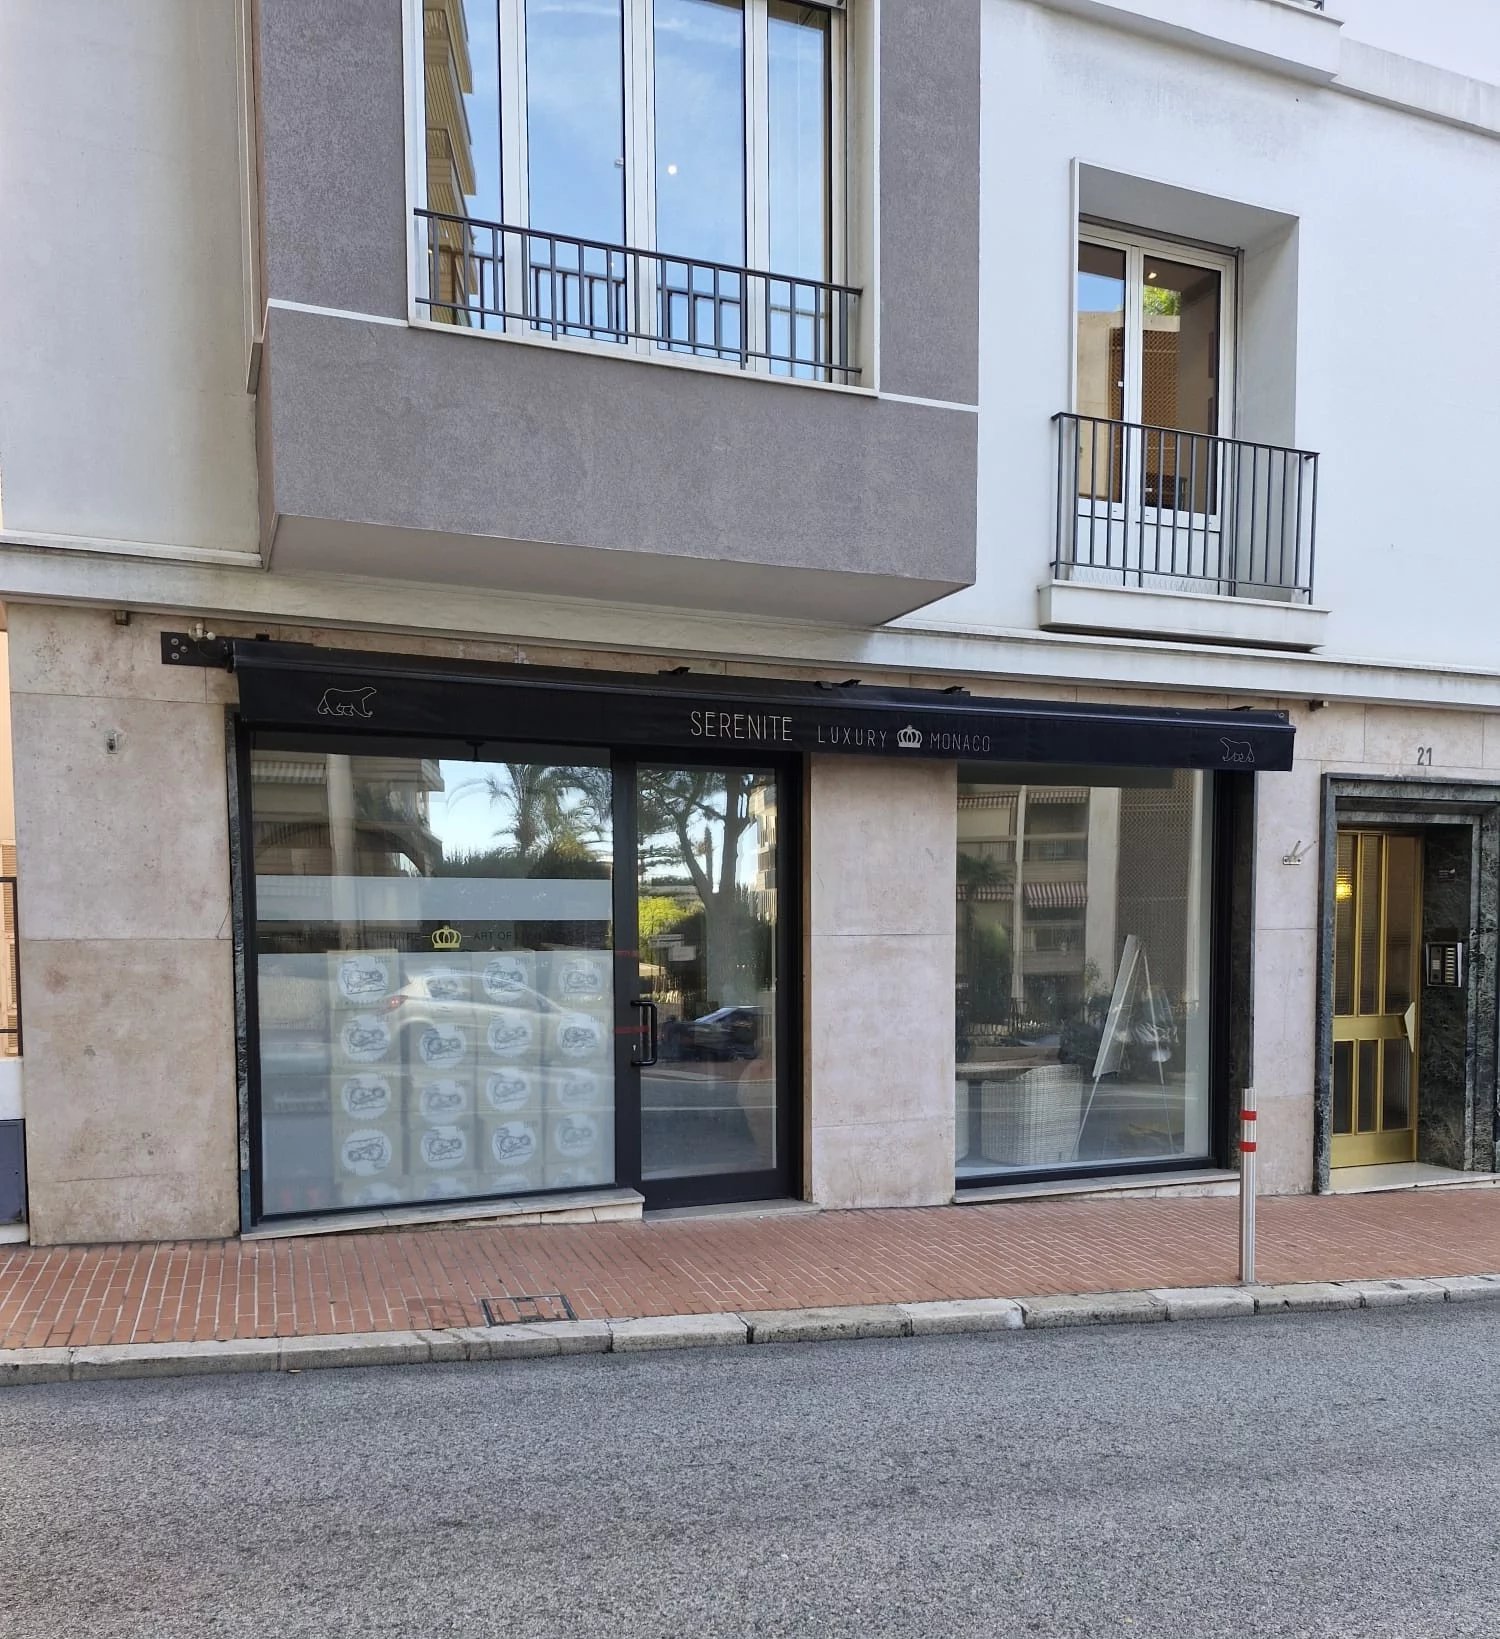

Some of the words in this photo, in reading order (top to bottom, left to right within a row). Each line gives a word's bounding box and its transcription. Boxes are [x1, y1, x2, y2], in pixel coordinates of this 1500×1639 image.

[690, 711, 793, 742] SERENITE
[817, 726, 888, 747] LUXURY
[930, 732, 991, 753] MONACO
[1417, 747, 1433, 766] 21
